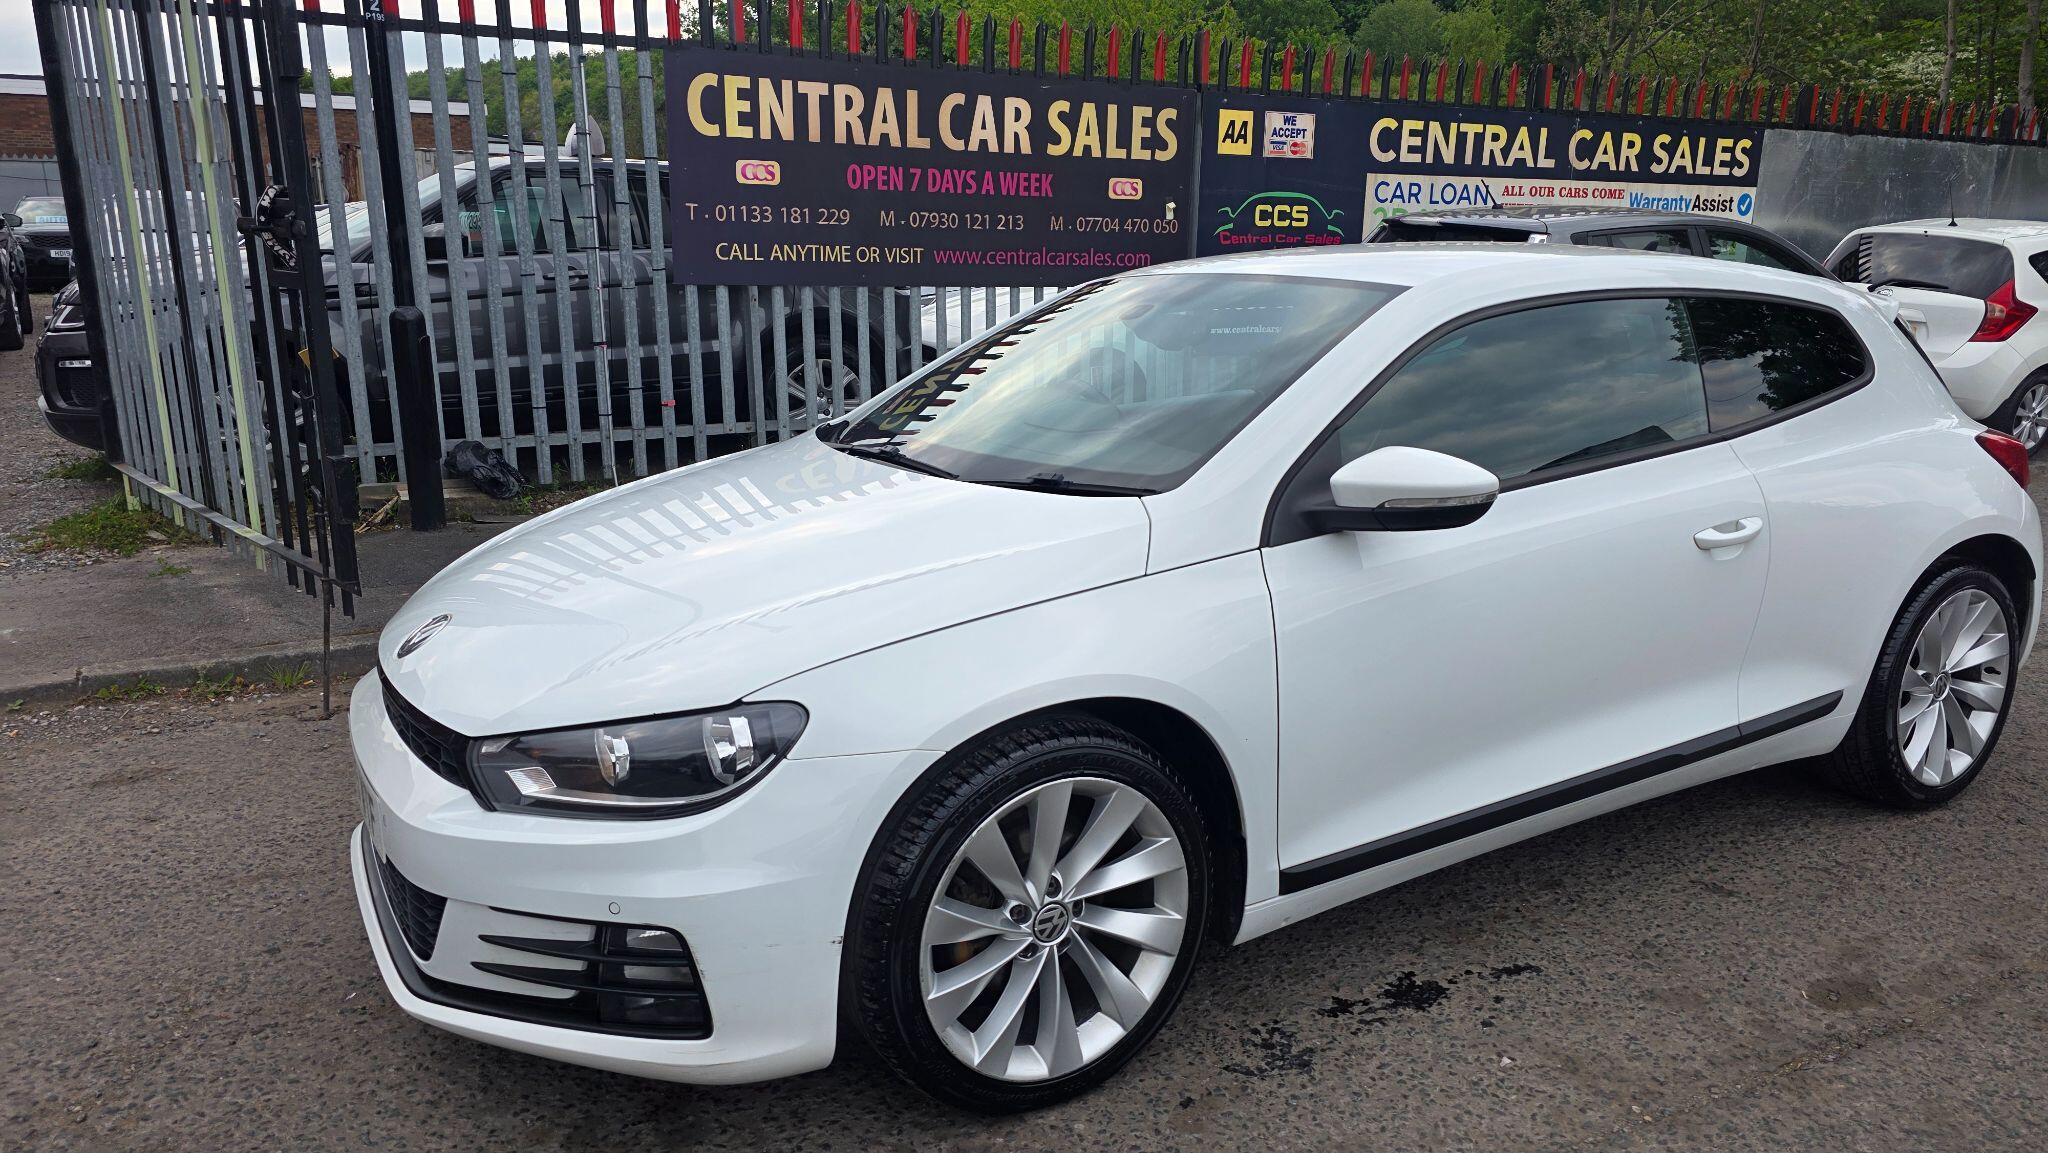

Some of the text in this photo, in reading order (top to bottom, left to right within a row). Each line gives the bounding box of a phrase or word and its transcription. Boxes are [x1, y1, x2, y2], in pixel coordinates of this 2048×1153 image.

[687, 72, 1178, 162] CENTRAL CAR SALES
[1283, 115, 1297, 126] WE
[1221, 119, 1249, 144] AA
[1271, 127, 1307, 139] ACCEPT
[1369, 117, 1753, 178] CENTRAL CAR SALES
[740, 163, 776, 182] CCS
[846, 163, 1054, 197] OPEN 7 DAYS A WEEK
[1112, 180, 1139, 197] CCS
[1374, 180, 1422, 204] CAR
[1502, 185, 1625, 199] ALL OUR CARS COME
[715, 204, 773, 223] 01133
[780, 207, 810, 224] 181
[816, 208, 850, 225] 229
[909, 211, 958, 229] 07930
[964, 213, 990, 230] 121
[997, 214, 1024, 230] 213
[1254, 204, 1309, 227] CCS
[1076, 217, 1120, 233] 07704
[1123, 218, 1149, 233] 470
[1153, 218, 1179, 234] 050
[1219, 231, 1342, 245] Central Car Sales
[715, 242, 1151, 267] CALL ANYTIME OR VISIT www.centralcarsales.com
